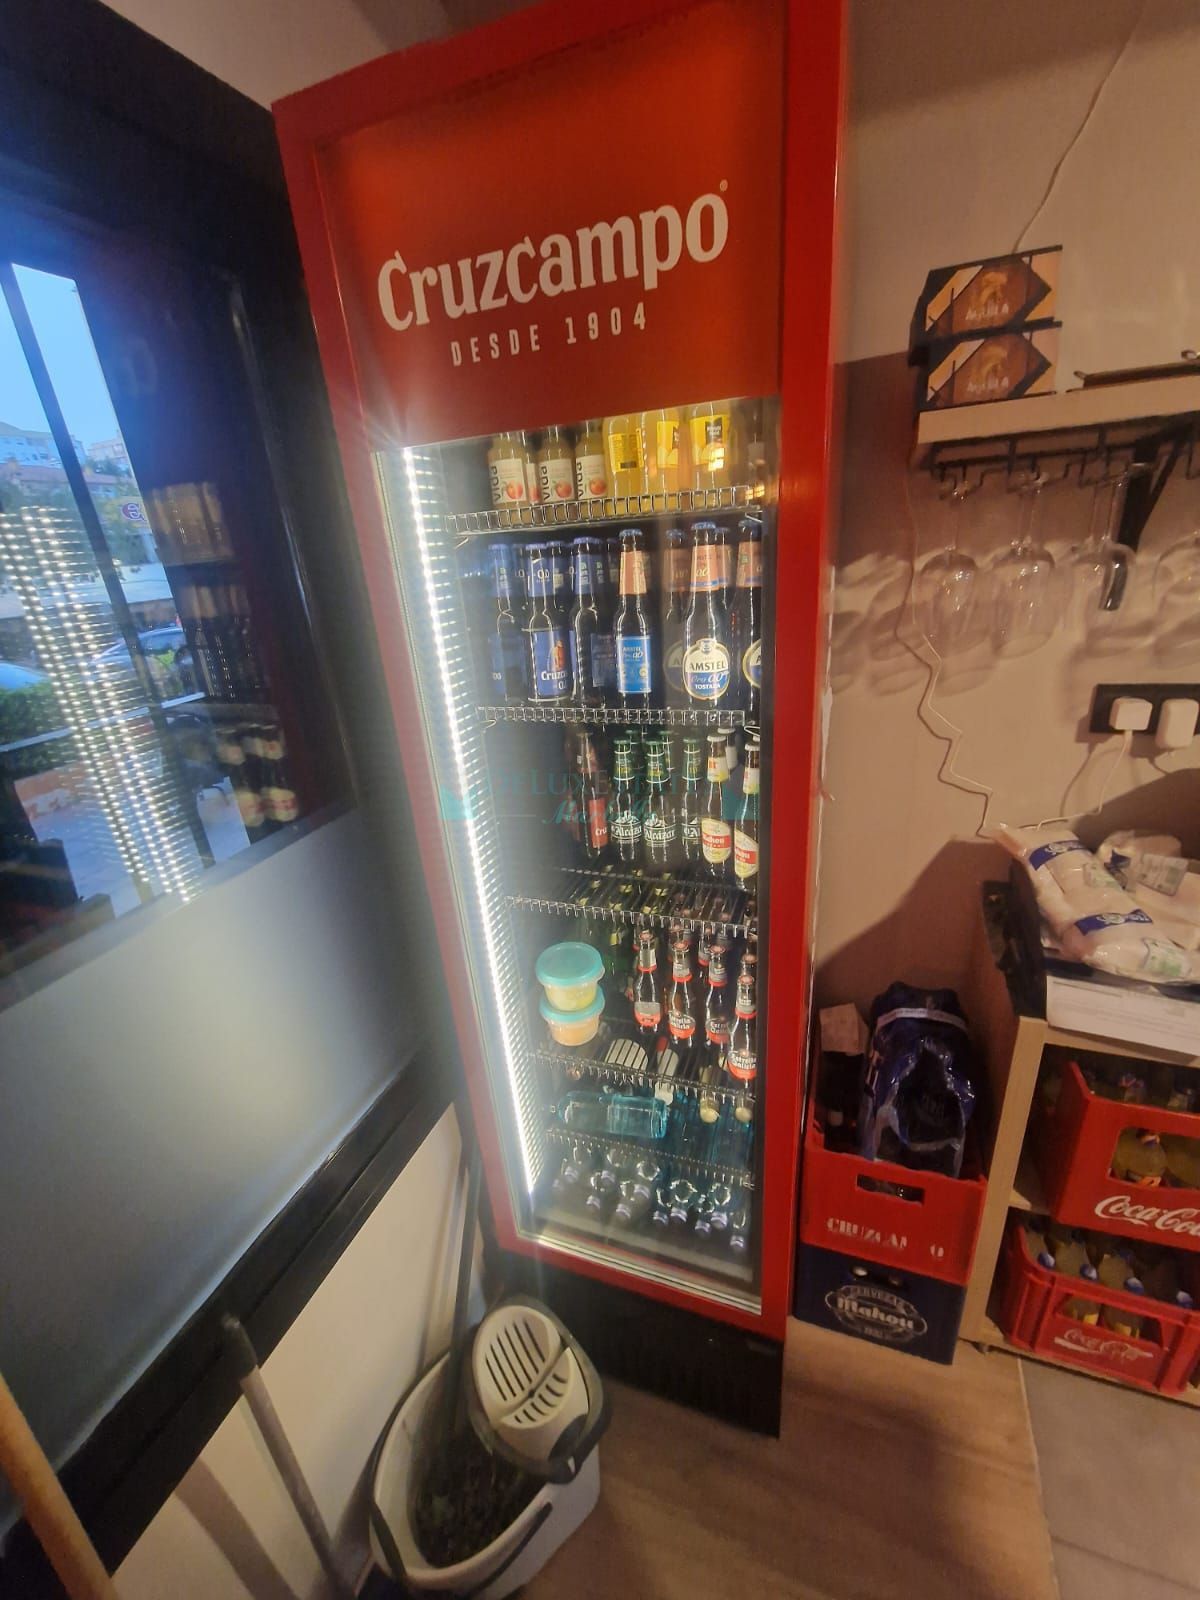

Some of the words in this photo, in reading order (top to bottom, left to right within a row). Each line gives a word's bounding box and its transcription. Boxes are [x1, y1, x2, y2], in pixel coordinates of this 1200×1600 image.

[377, 192, 729, 331] Cruzcampo
[451, 324, 541, 367] DESDE
[565, 302, 647, 345] 1904
[689, 661, 726, 671] AMSTEL
[837, 1297, 915, 1330] Mahou
